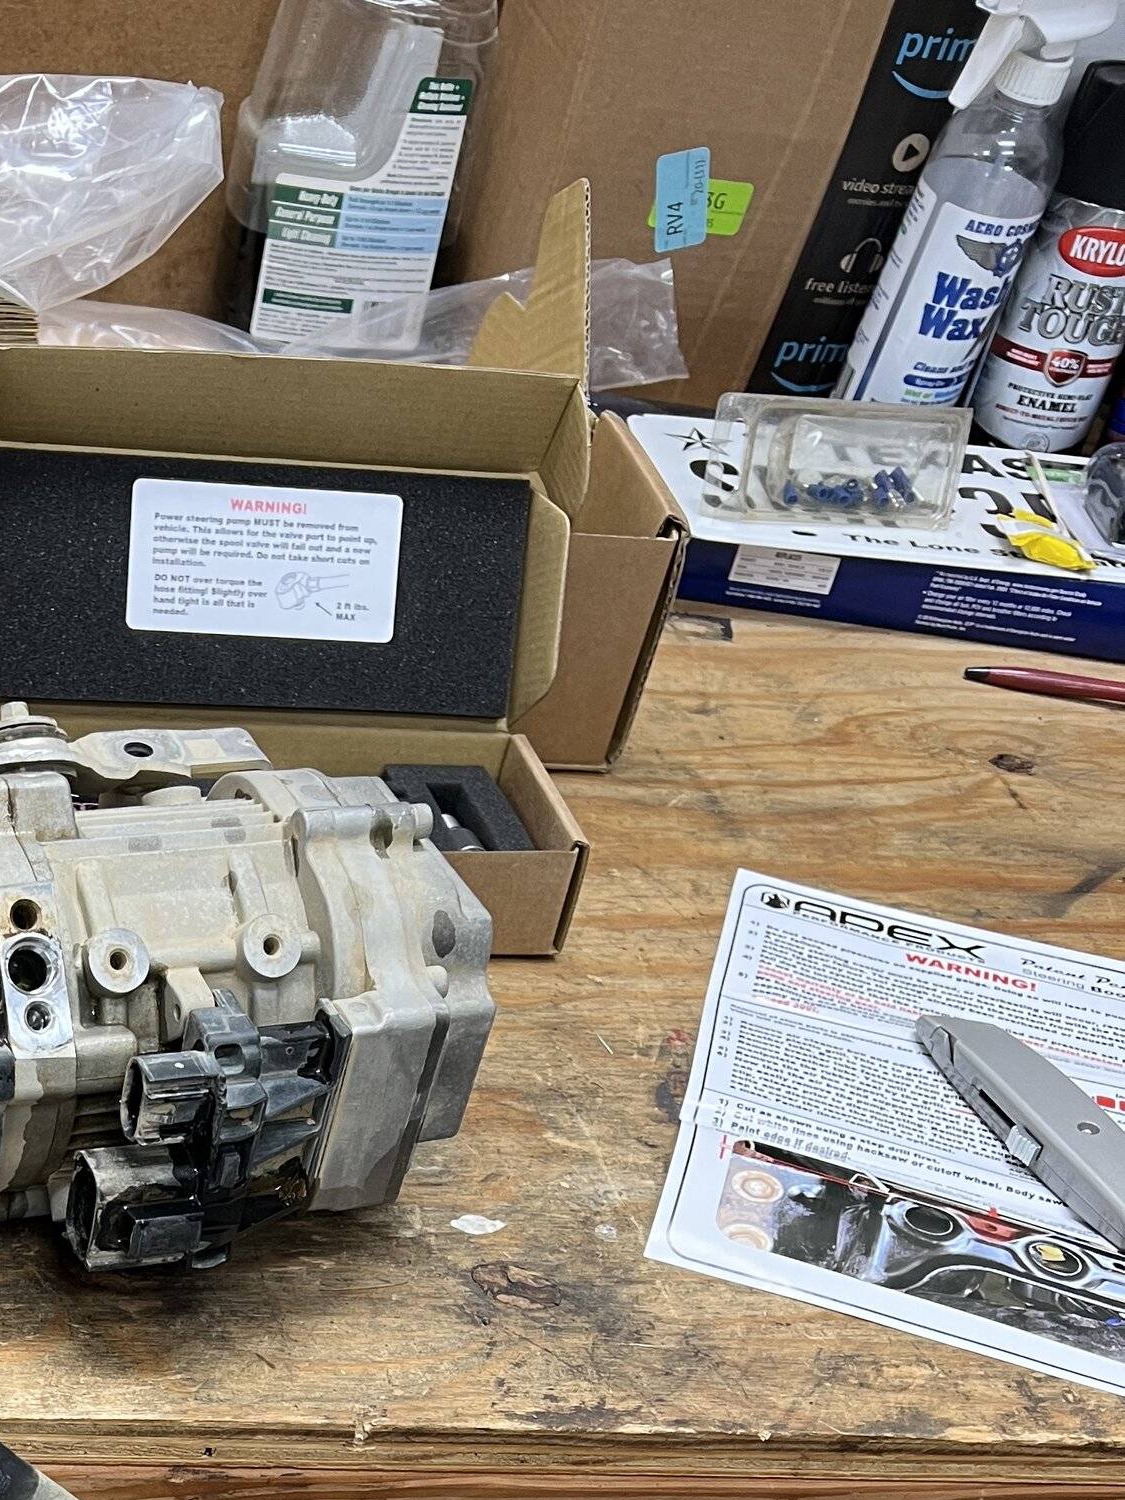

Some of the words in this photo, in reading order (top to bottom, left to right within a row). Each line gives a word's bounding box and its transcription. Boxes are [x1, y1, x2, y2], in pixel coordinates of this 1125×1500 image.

[896, 27, 976, 65] prim
[842, 178, 879, 193] video
[965, 219, 1003, 237] AERO
[1069, 234, 1125, 267] KRYLO
[805, 277, 835, 293] free
[837, 280, 874, 294] liste
[918, 303, 986, 341] Wax
[776, 336, 848, 367] prim
[1051, 355, 1081, 371] 40%
[1016, 394, 1078, 413] ENAMEL
[230, 498, 307, 515] WARNING!
[154, 512, 183, 521] Power
[186, 515, 223, 525] steering
[226, 518, 251, 526] pump
[254, 517, 281, 527] MUST
[154, 524, 190, 532] vehicle.
[153, 535, 199, 544] otherwise
[842, 533, 899, 547] The
[909, 537, 980, 554] Lone
[311, 555, 334, 563] short
[154, 596, 175, 604] hand
[178, 597, 199, 607] tight
[227, 600, 244, 608] that
[336, 613, 355, 621] MAX
[906, 953, 1038, 992] WARNING!
[731, 1121, 761, 1136] Paint
[736, 1103, 756, 1114] Cut
[775, 1114, 813, 1129] shown
[815, 1126, 846, 1139] using
[822, 1135, 854, 1151] using
[856, 1144, 908, 1164] hacksaw
[912, 1160, 923, 1168] or
[927, 1164, 962, 1178] cutoff
[964, 1175, 1003, 1190] wheel.
[1005, 1186, 1034, 1200] Body
